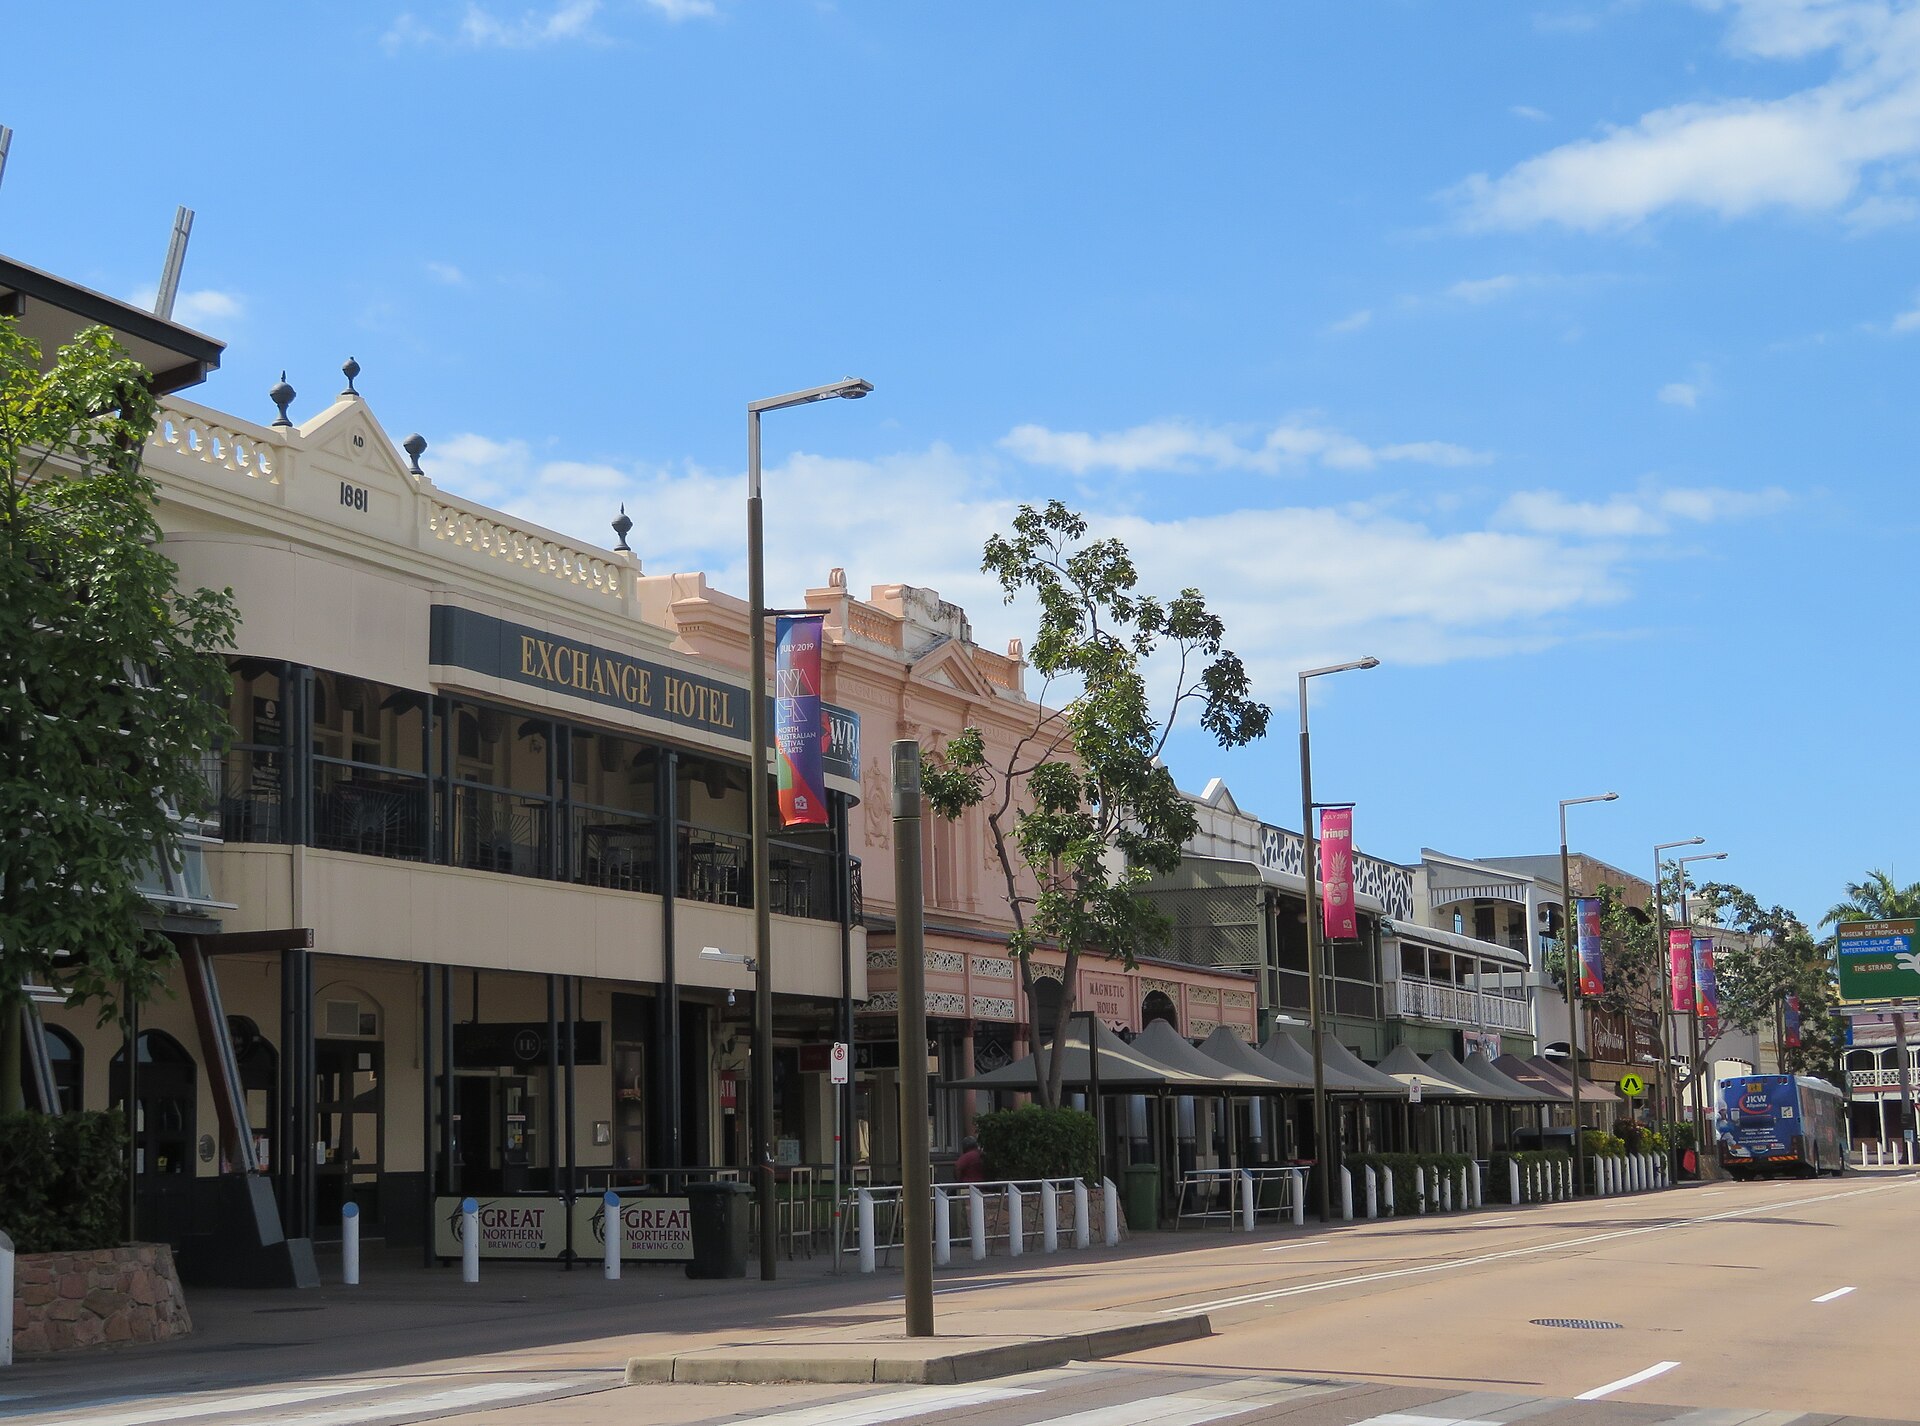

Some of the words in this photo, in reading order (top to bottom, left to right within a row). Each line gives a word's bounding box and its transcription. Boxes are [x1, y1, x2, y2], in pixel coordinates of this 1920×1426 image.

[353, 435, 364, 448] AD
[340, 481, 368, 513] 1881
[780, 644, 795, 654] JULY
[797, 642, 814, 652] 2019
[520, 635, 652, 706] EXCHANGE
[663, 675, 735, 729] HOTEL
[778, 726, 799, 734] NORTH
[778, 731, 816, 740] AUSTRALIAN
[778, 739, 805, 748] FESTIVAL
[1323, 828, 1349, 840] fringe
[1841, 946, 1884, 954] ENTERTAINMENT
[1868, 963, 1893, 971] STRAND
[1089, 981, 1125, 998] MAGNETIC
[1096, 1001, 1119, 1015] HOUSE
[720, 1079, 737, 1097] ATM
[1745, 1094, 1767, 1104] JKW
[481, 1209, 545, 1228] GREAT
[624, 1209, 692, 1229] GREAT
[482, 1229, 544, 1240] NORTHERN
[626, 1230, 690, 1241] NORTHERN
[488, 1241, 523, 1249] BREWING
[525, 1241, 539, 1249] CO.
[631, 1242, 669, 1250] BREWING
